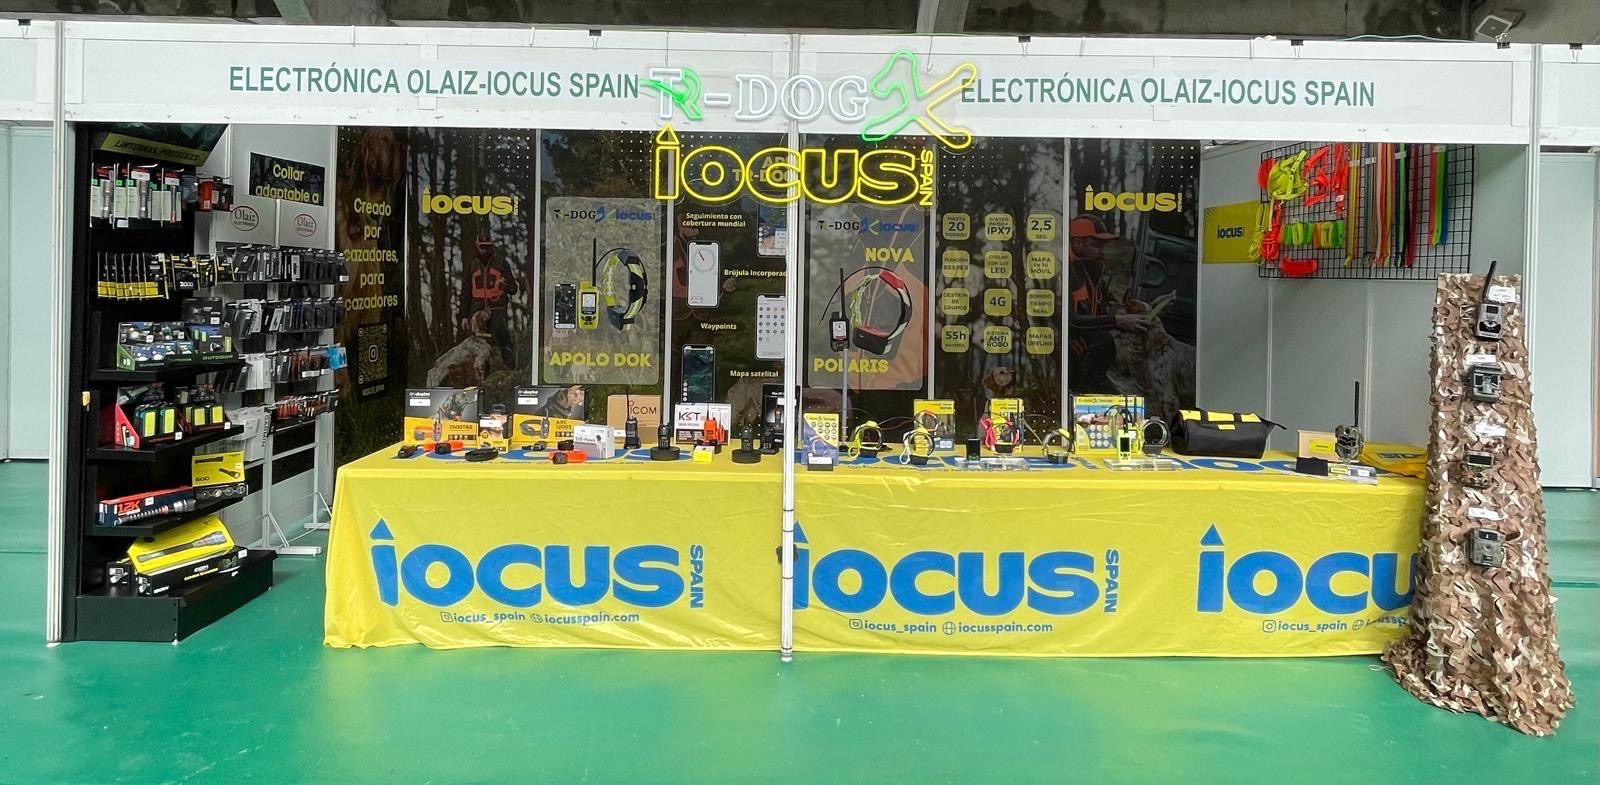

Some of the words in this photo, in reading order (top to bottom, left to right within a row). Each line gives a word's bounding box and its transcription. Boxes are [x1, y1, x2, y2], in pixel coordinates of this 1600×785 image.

[230, 62, 400, 94] ELECTRÓNICA
[406, 68, 560, 98] OLAIZ-IOCUS
[568, 72, 639, 99] SPAIN
[961, 72, 1134, 104] ELECTRÓNICA
[1140, 78, 1297, 106] OLAIZ-IOCUS
[1304, 80, 1375, 107] SPAIN
[272, 163, 304, 182] Collar
[919, 148, 935, 206] SPAIN
[256, 183, 310, 202] adaptable
[312, 192, 320, 204] a
[353, 197, 392, 217] Creado
[686, 212, 728, 222] Seguimiento
[718, 220, 746, 228] mundial
[364, 225, 382, 241] por
[948, 222, 965, 232] 20
[987, 226, 1011, 235] IPX7
[1031, 220, 1052, 232] 2,5
[344, 247, 399, 263] cazadores,
[866, 247, 914, 262] NOVA
[360, 271, 384, 288] para
[724, 268, 748, 278] Brújula
[344, 294, 398, 312] cazadores
[990, 296, 1006, 306] 4G
[700, 322, 737, 330] Waypoints
[946, 331, 966, 340] 55h
[549, 352, 610, 367] APOLO
[614, 352, 652, 367] DOK
[813, 357, 889, 374] POLARIS
[730, 370, 750, 378] Mapa
[678, 412, 700, 421] KST
[117, 500, 141, 514] 12K
[1196, 522, 1420, 615] iocu
[689, 544, 704, 609] SPAIN
[1103, 548, 1120, 614] SPAIN
[453, 611, 526, 624] iocus_spain
[544, 611, 640, 625] iocusspain.com
[864, 620, 936, 634] iocus_spain
[958, 621, 1054, 634] iocusspain.com
[1278, 620, 1348, 633] iocus_spain
